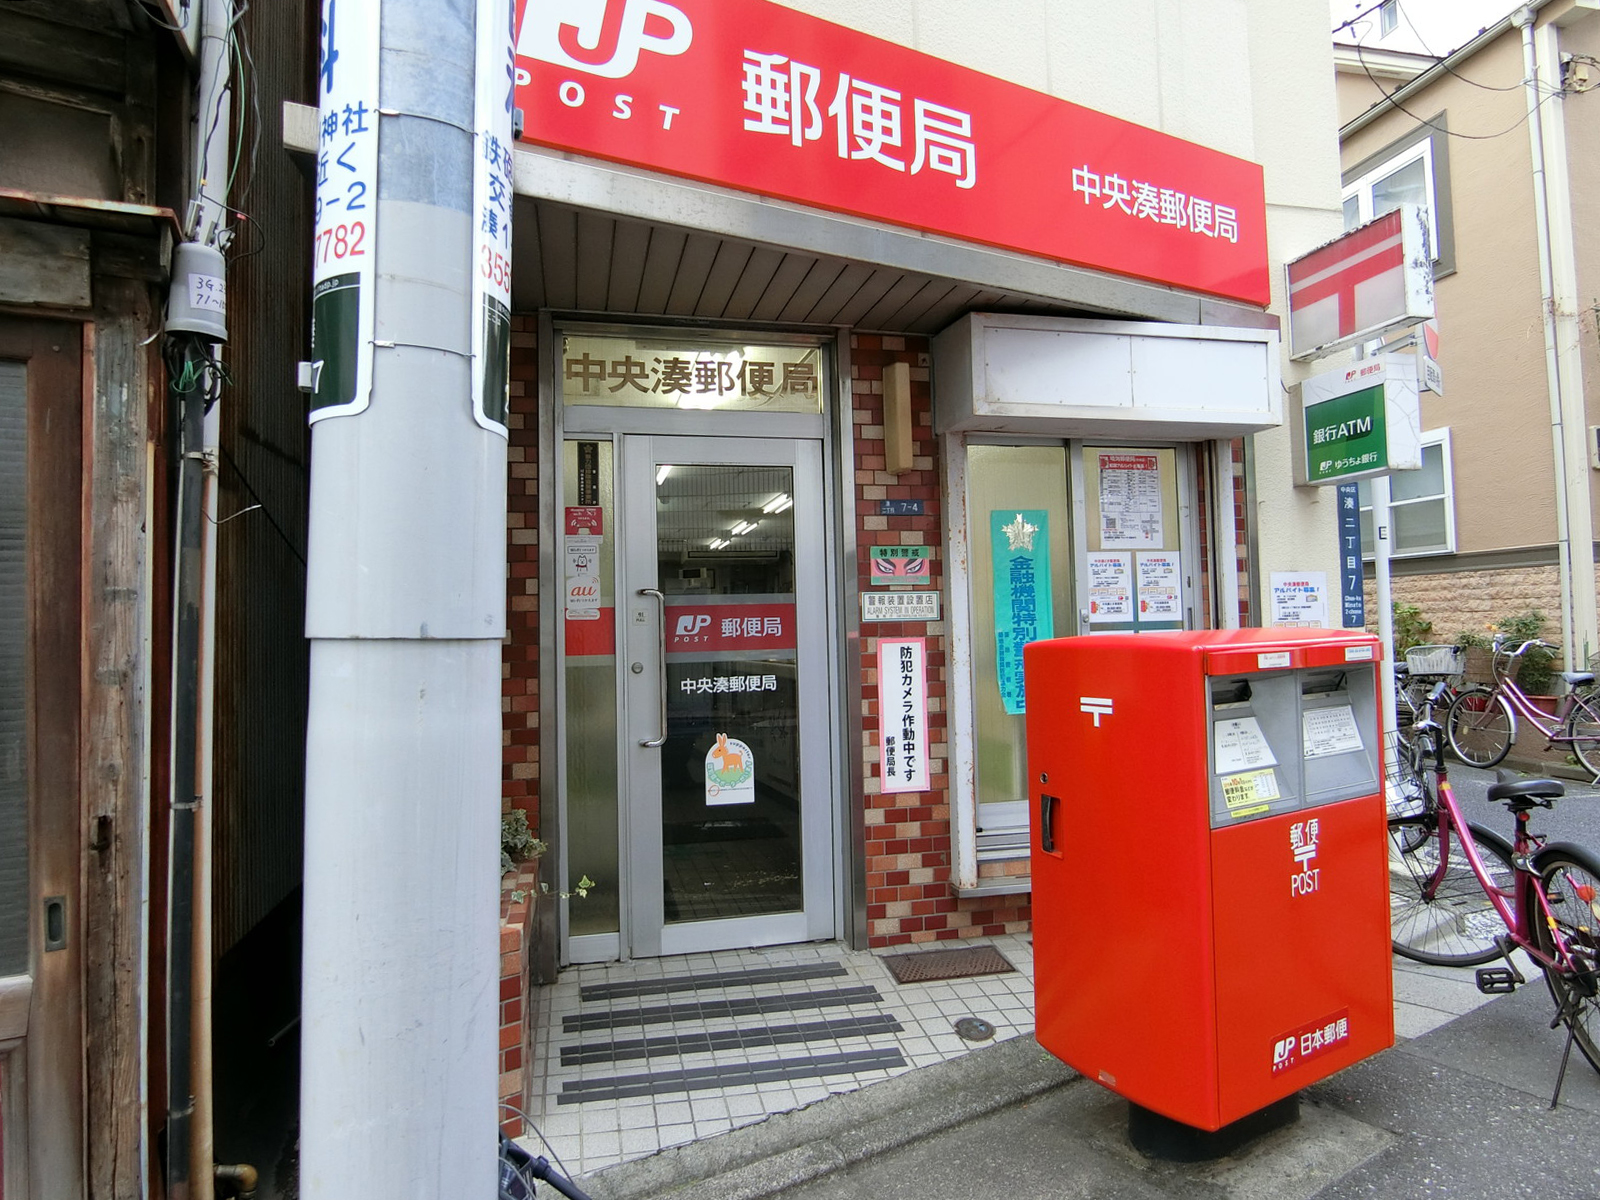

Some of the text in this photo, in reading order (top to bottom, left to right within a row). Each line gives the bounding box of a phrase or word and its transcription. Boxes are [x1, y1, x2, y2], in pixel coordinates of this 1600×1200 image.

[514, 67, 680, 130] POST
[742, 49, 977, 190] 郵便局
[1071, 163, 1238, 244] 中央湊郵便局
[566, 353, 818, 397] 中央湊郵便局
[1360, 363, 1381, 377] 郵便局
[1313, 416, 1371, 445] 銀行ATM
[1335, 451, 1378, 470] ゆうちょ銀行
[901, 502, 919, 512] 7-4
[879, 548, 920, 557] 特別警戒
[570, 586, 597, 597] au
[868, 595, 933, 605] 警報装置設置店
[867, 606, 883, 615] ALARM
[911, 605, 934, 614] OPERATION
[676, 615, 711, 635] JP
[721, 617, 782, 638] 郵便局
[674, 635, 709, 643] POST
[681, 674, 777, 695] 中央湊郵便局
[900, 647, 916, 781] 防犯カメラ作動中です
[885, 736, 896, 777] 郵便局長
[1290, 819, 1319, 850] 郵便
[1291, 869, 1319, 897] POST
[1300, 1017, 1347, 1056] 日本郵便
[1274, 1036, 1295, 1064] JP
[1272, 1057, 1295, 1073] POST
